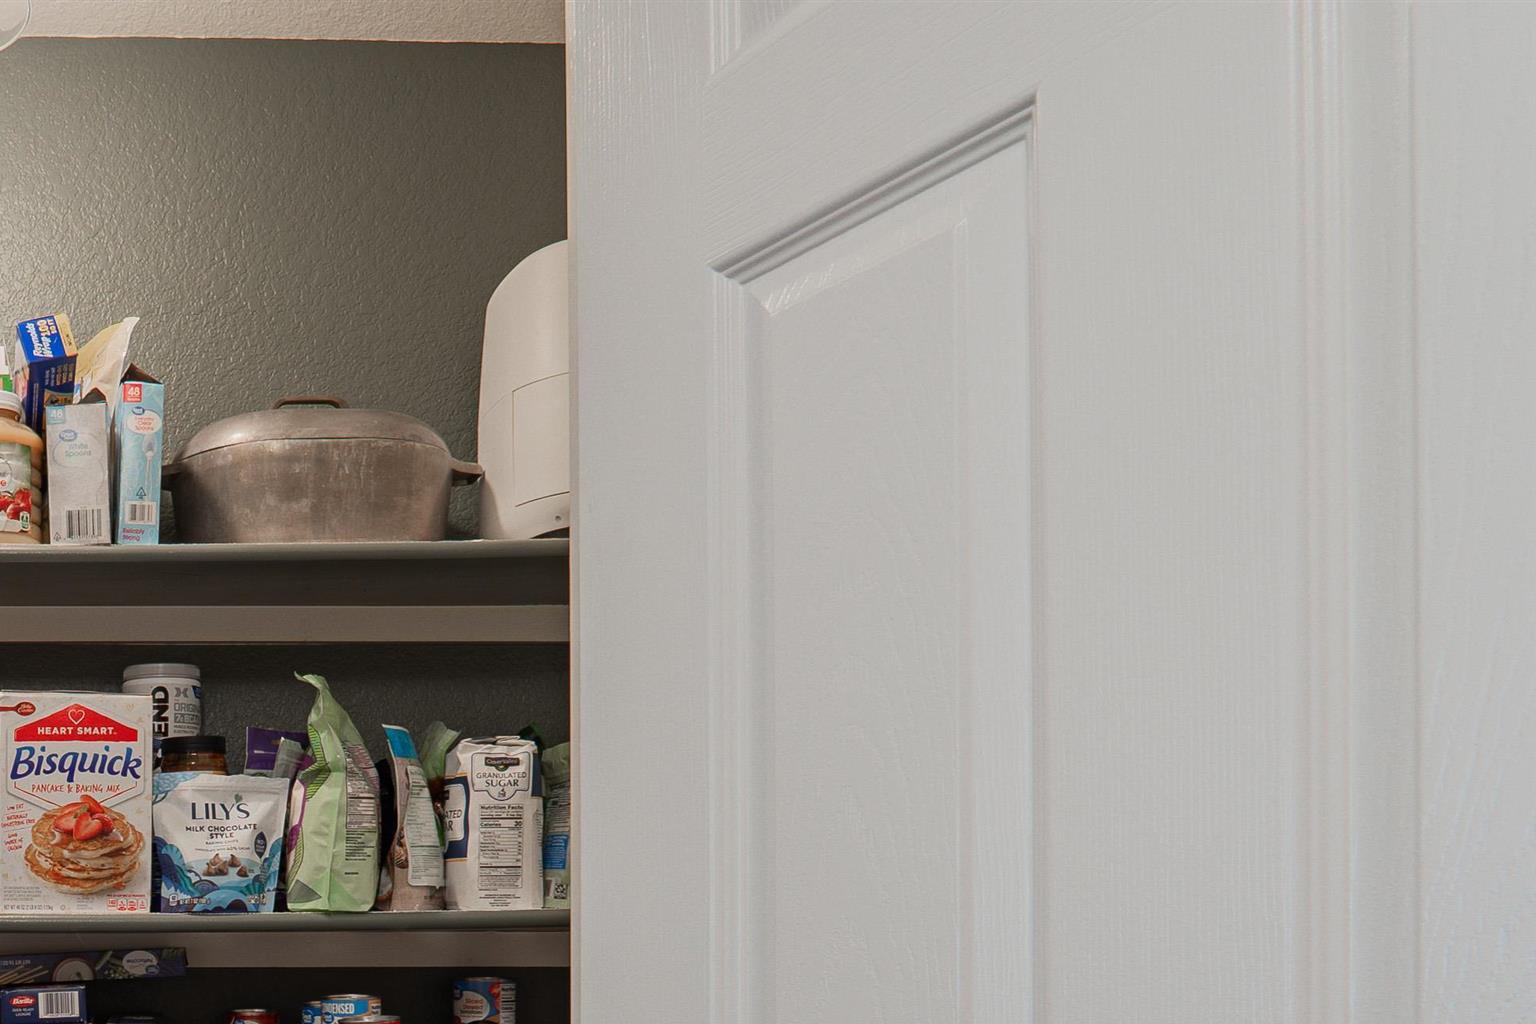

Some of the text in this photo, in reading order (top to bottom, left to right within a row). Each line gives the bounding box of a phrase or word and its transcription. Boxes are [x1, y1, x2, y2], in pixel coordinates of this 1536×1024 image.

[37, 319, 51, 336] 100
[127, 386, 141, 397] 48
[50, 408, 64, 419] 48
[65, 450, 92, 458] Spoons
[37, 726, 114, 735] HEART SMART
[10, 745, 143, 783] Bisquick
[475, 771, 527, 779] GRANULATED
[485, 779, 520, 788] SUGAR
[31, 784, 121, 793] PANCAKE & BAKING MIX
[207, 823, 258, 833] CHOCOLATE
[209, 832, 235, 840] STYLE
[11, 997, 34, 1005] Barilla
